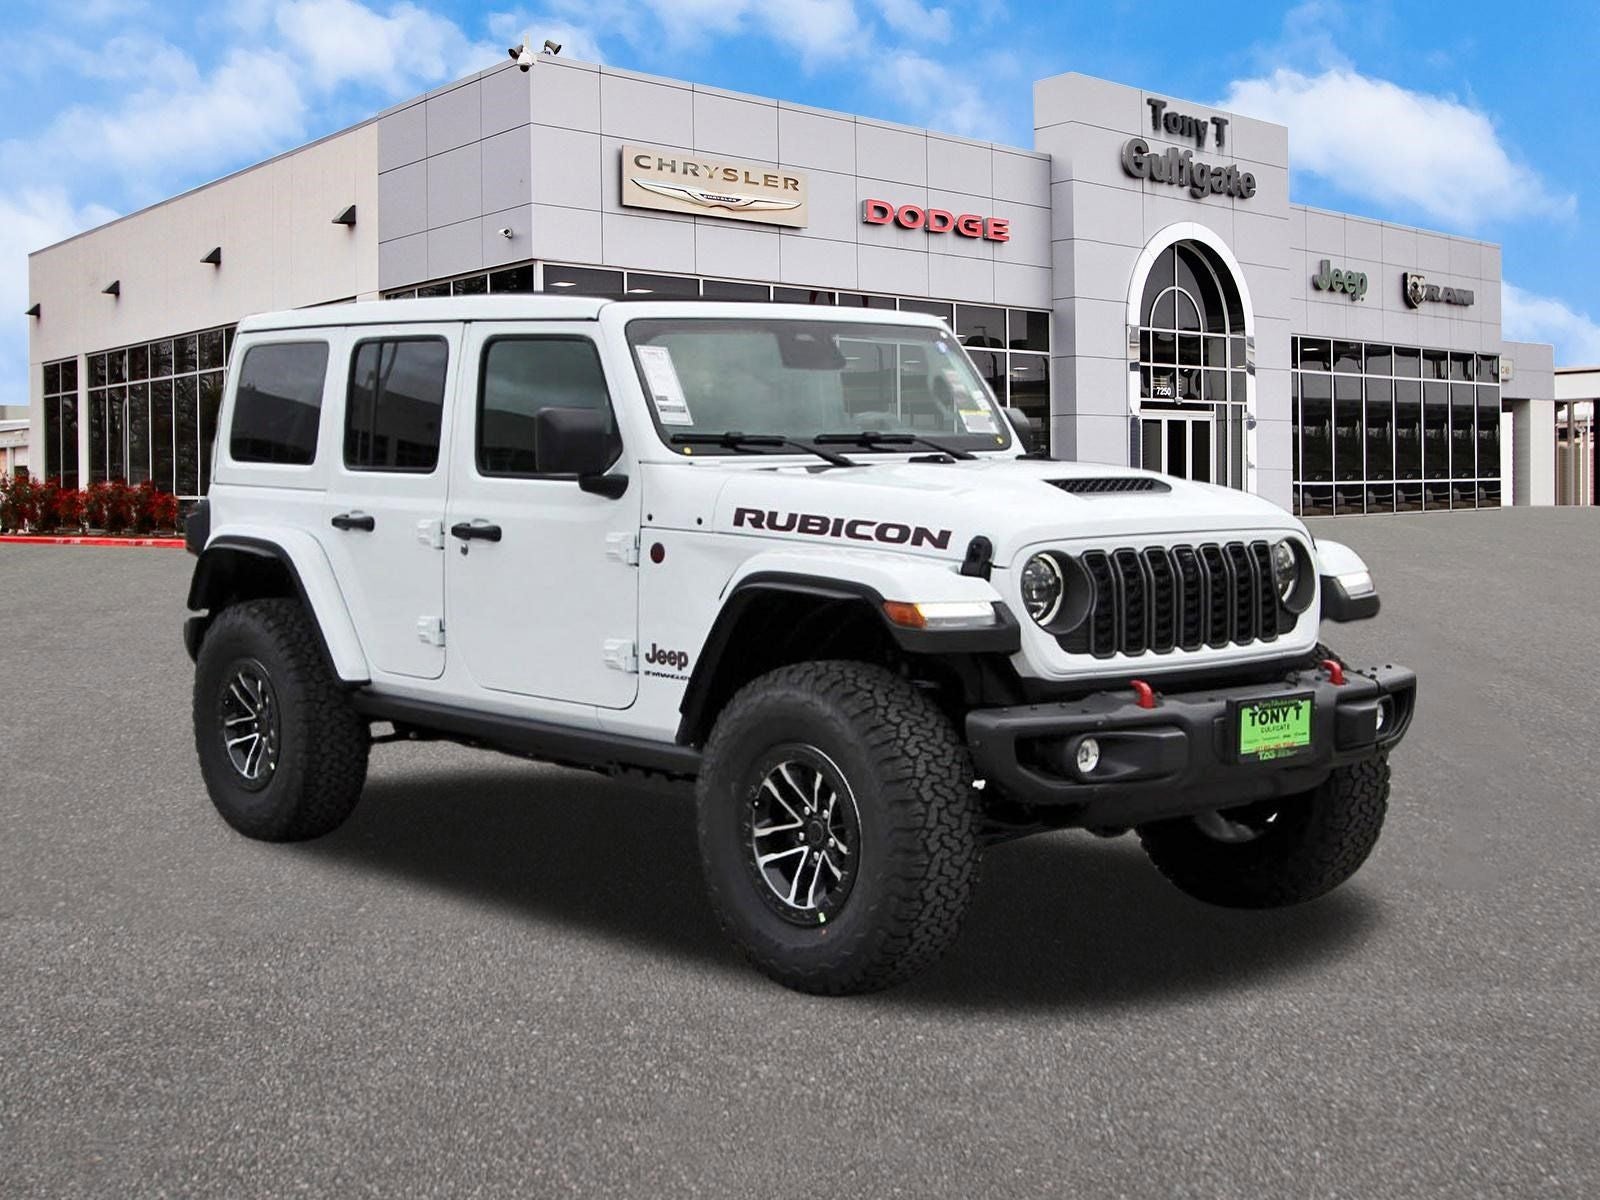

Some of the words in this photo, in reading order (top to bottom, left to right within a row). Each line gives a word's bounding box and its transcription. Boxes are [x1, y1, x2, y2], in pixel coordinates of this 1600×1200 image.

[1146, 98, 1208, 147] Tony
[1211, 116, 1229, 147] T
[633, 154, 800, 191] CHRYSLER
[1121, 138, 1256, 199] Gulfgate
[862, 199, 1010, 242] DODGE
[1312, 259, 1368, 301] Jeep
[1424, 283, 1475, 306] RAM
[1156, 386, 1172, 396] 7250
[733, 507, 952, 549] RUBICON
[645, 643, 689, 671] Jeep
[1249, 707, 1290, 727] TONY
[1294, 705, 1303, 721] T
